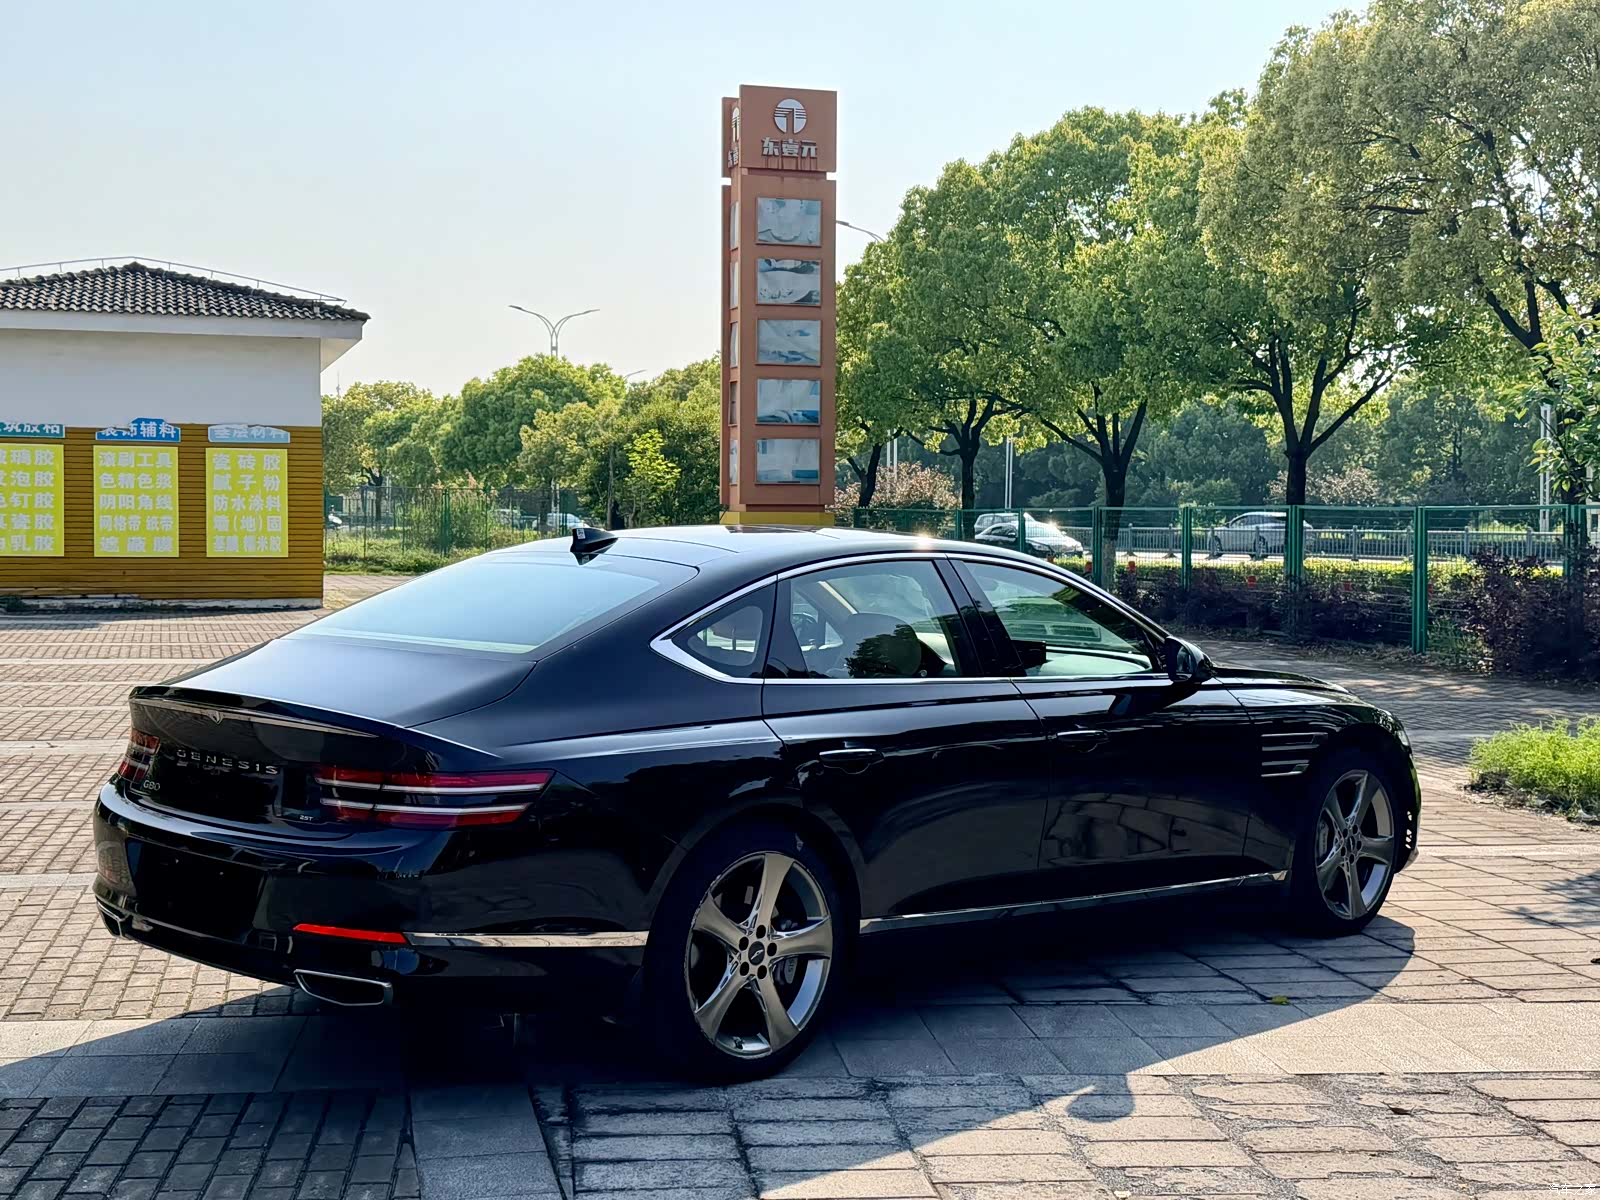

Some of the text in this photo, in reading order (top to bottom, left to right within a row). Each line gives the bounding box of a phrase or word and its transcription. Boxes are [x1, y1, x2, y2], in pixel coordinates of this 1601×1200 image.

[762, 136, 818, 158] 东壹元
[99, 451, 173, 468] 滚刷工具
[213, 453, 281, 470] 瓷砖胶
[99, 472, 173, 489] 色精色浆
[213, 473, 281, 491] 腻子粉
[99, 494, 173, 511] 阴阳角线
[213, 494, 281, 512] 防水涂料
[176, 749, 278, 775] GENESIS
[143, 779, 161, 791] G80
